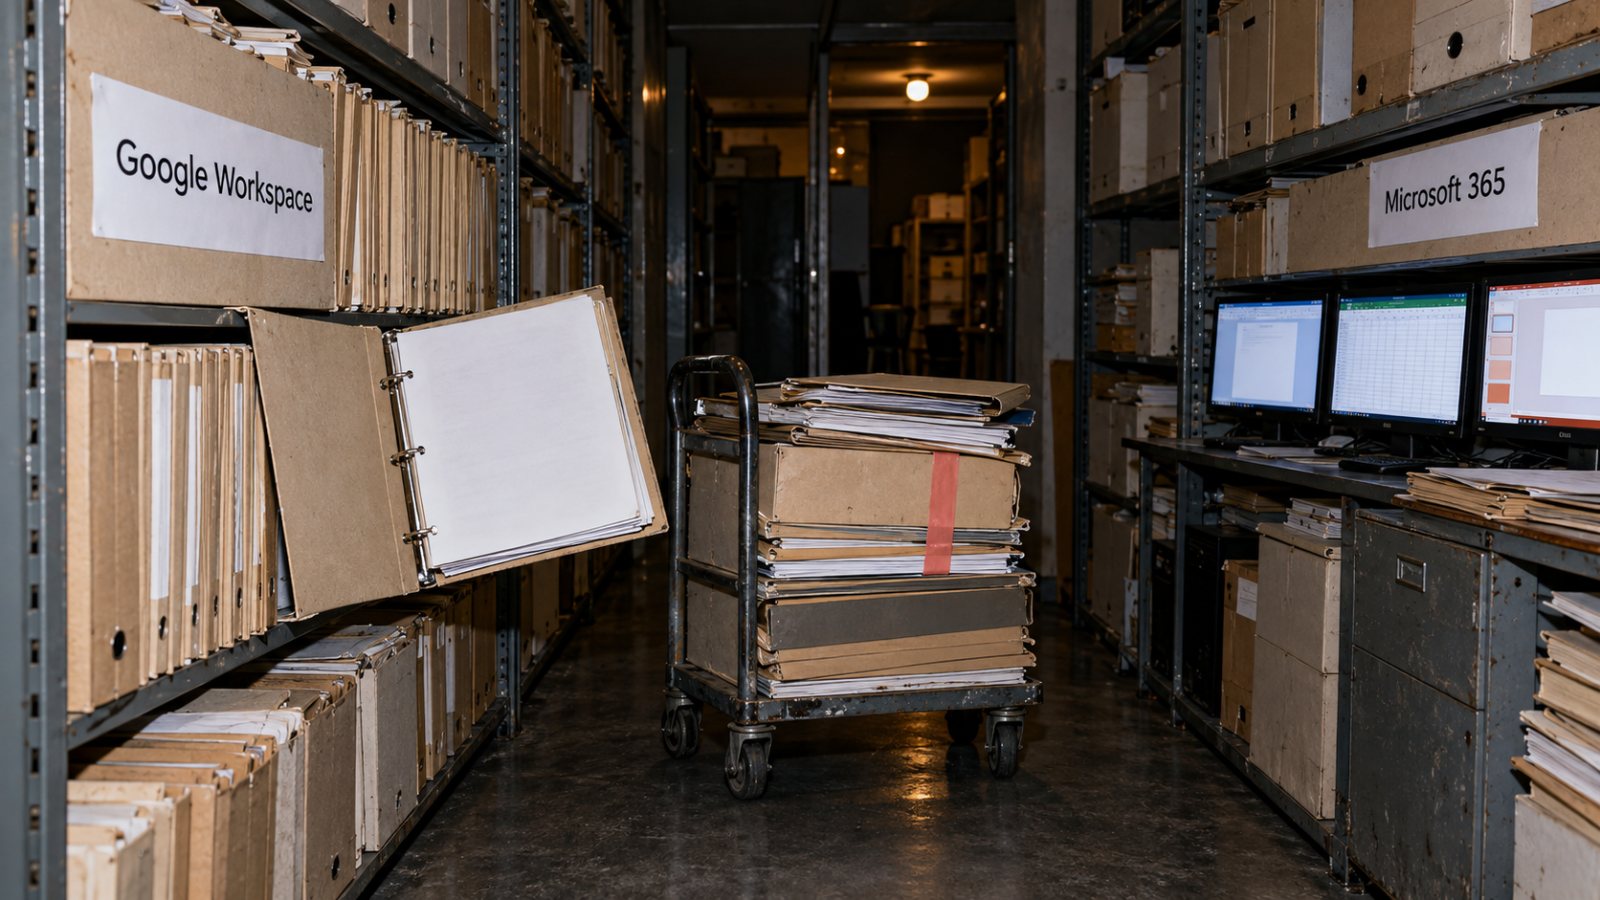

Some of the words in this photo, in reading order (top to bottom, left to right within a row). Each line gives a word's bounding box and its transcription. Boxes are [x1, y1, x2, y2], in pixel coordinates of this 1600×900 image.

[116, 138, 208, 197] Google
[214, 161, 313, 214] Workspace
[1384, 174, 1462, 215] Microsoft
[1467, 166, 1506, 200] 365
